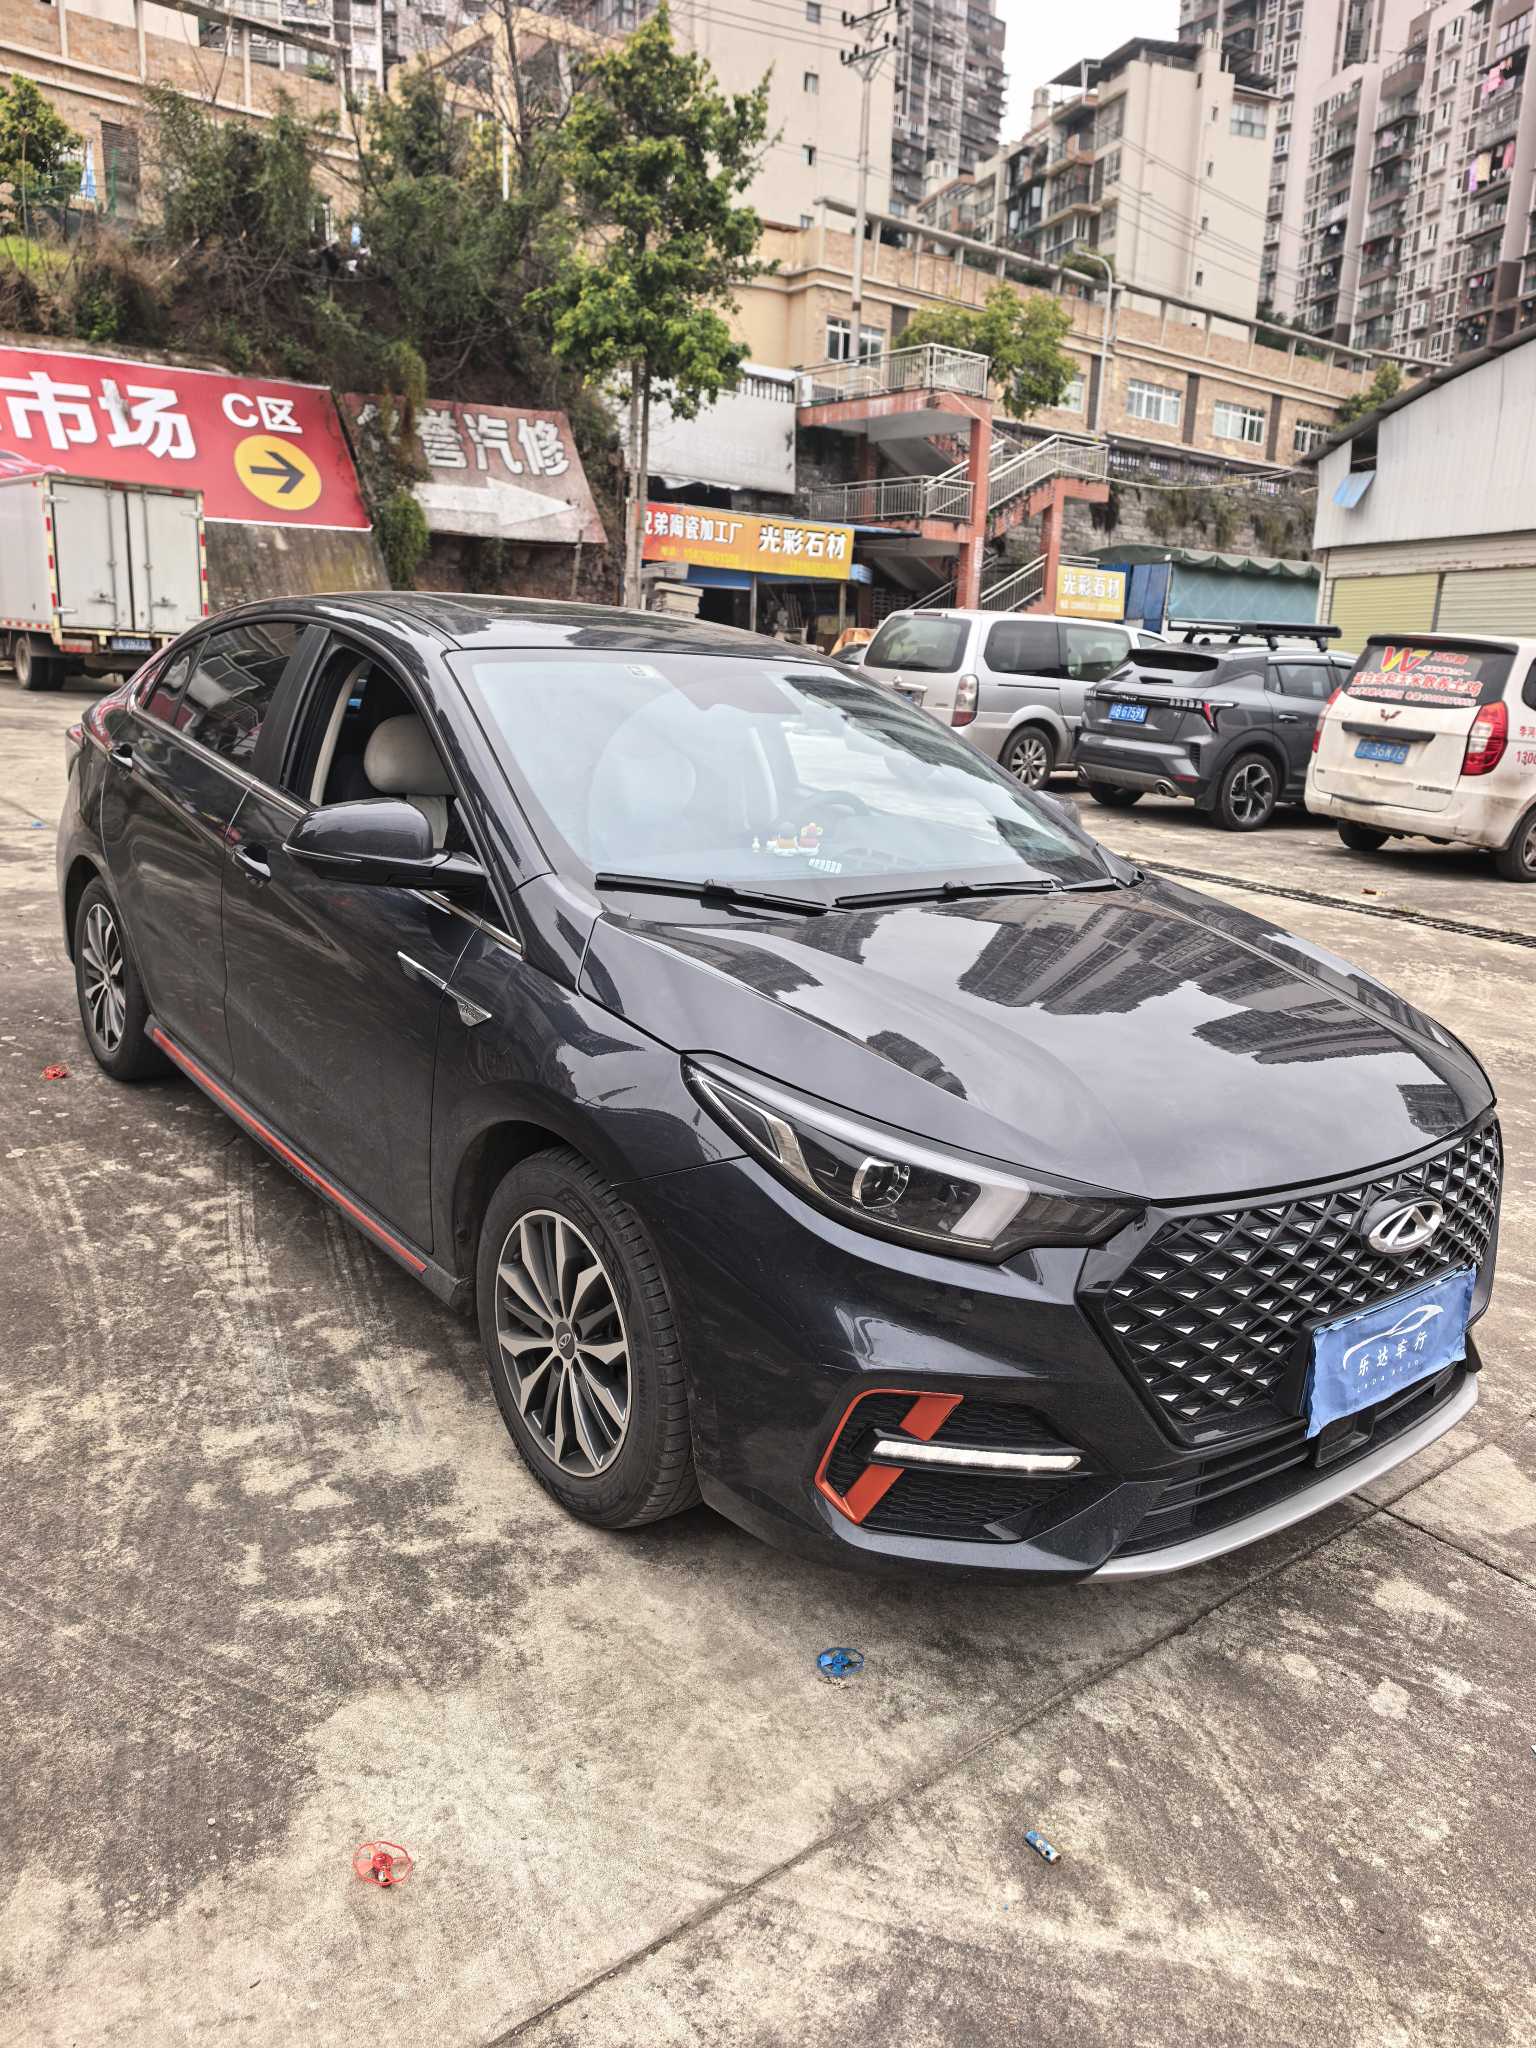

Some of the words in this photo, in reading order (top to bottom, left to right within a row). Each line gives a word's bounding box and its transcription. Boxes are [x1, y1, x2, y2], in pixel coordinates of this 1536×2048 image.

[0, 371, 197, 460] 市场
[222, 392, 304, 435] C区
[759, 525, 847, 560] 光彩石材
[1062, 571, 1121, 600] 光彩石材
[1358, 1331, 1428, 1377] 乐达车行
